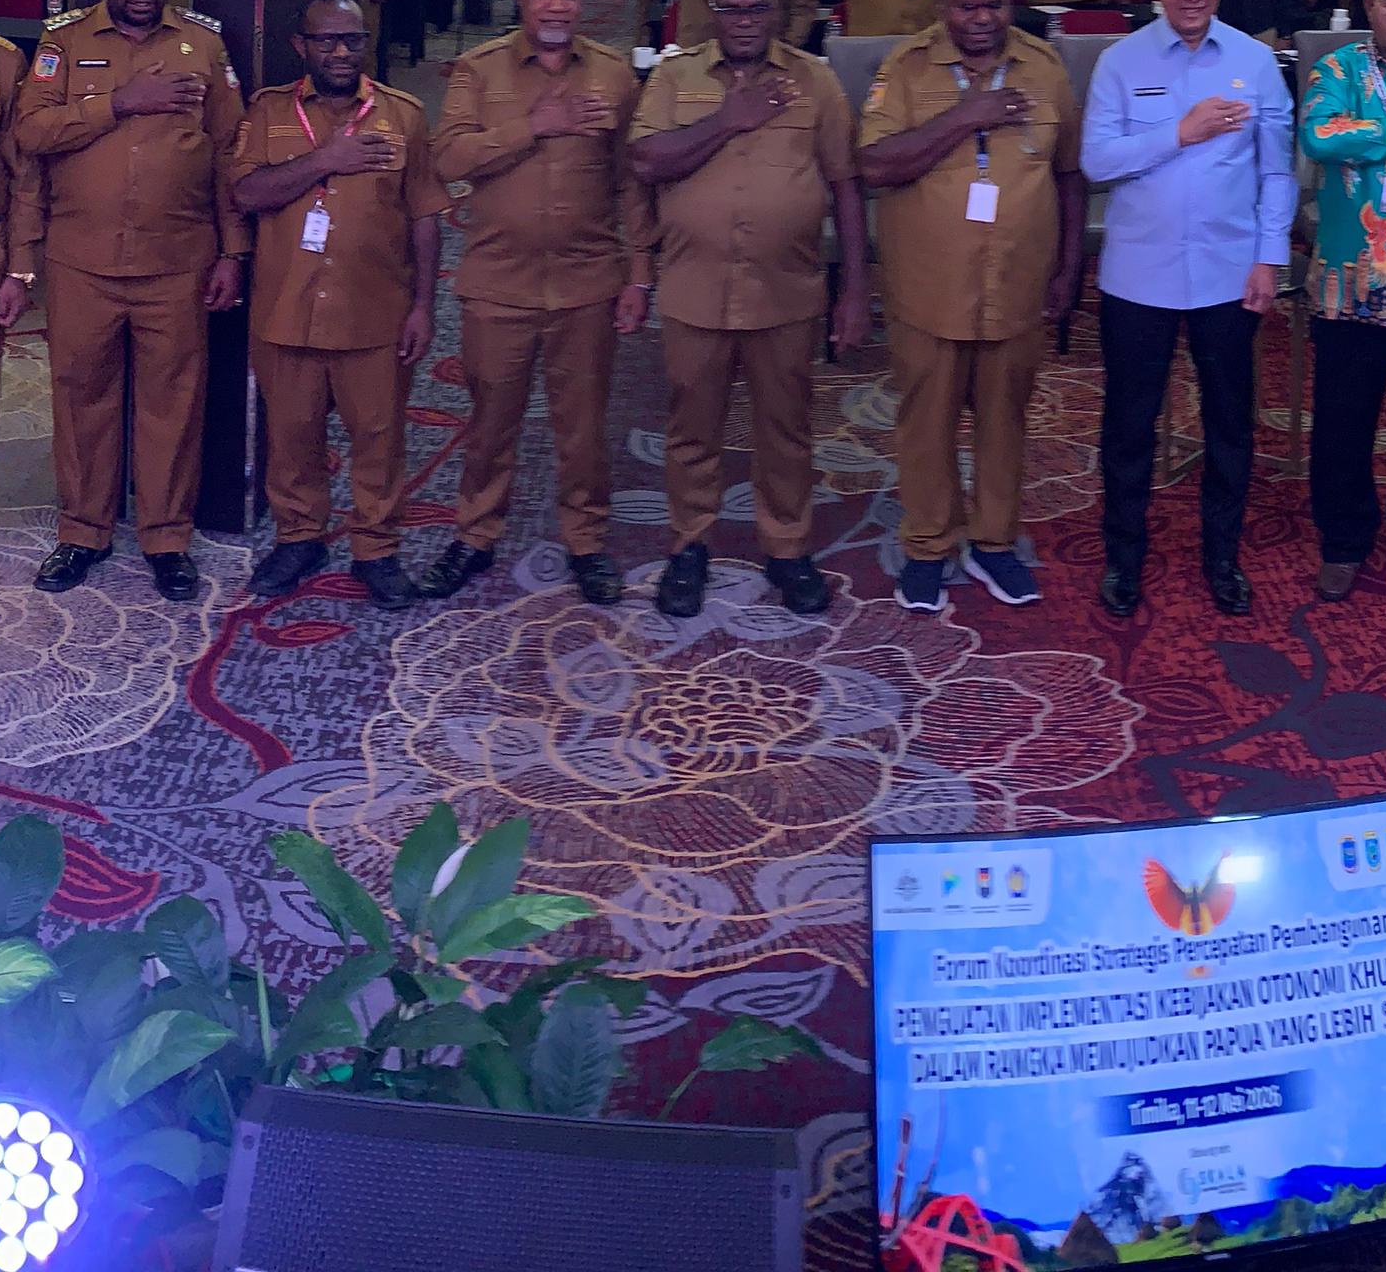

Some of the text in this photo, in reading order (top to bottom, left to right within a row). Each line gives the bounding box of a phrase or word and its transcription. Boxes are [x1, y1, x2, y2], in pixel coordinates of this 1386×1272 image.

[933, 954, 991, 980] Forum
[992, 943, 1090, 979] Koordinasi
[1091, 935, 1170, 973] Strategis
[1173, 930, 1269, 965] Percepatan
[1015, 992, 1151, 1031] IMPLEMENTASI
[1156, 978, 1255, 1018] KEBIJAKAN
[1258, 964, 1347, 1004] OTONOMI
[1204, 1023, 1266, 1057] PAPUA
[1266, 1014, 1317, 1048] YANG
[1321, 1004, 1376, 1039] LEBIH
